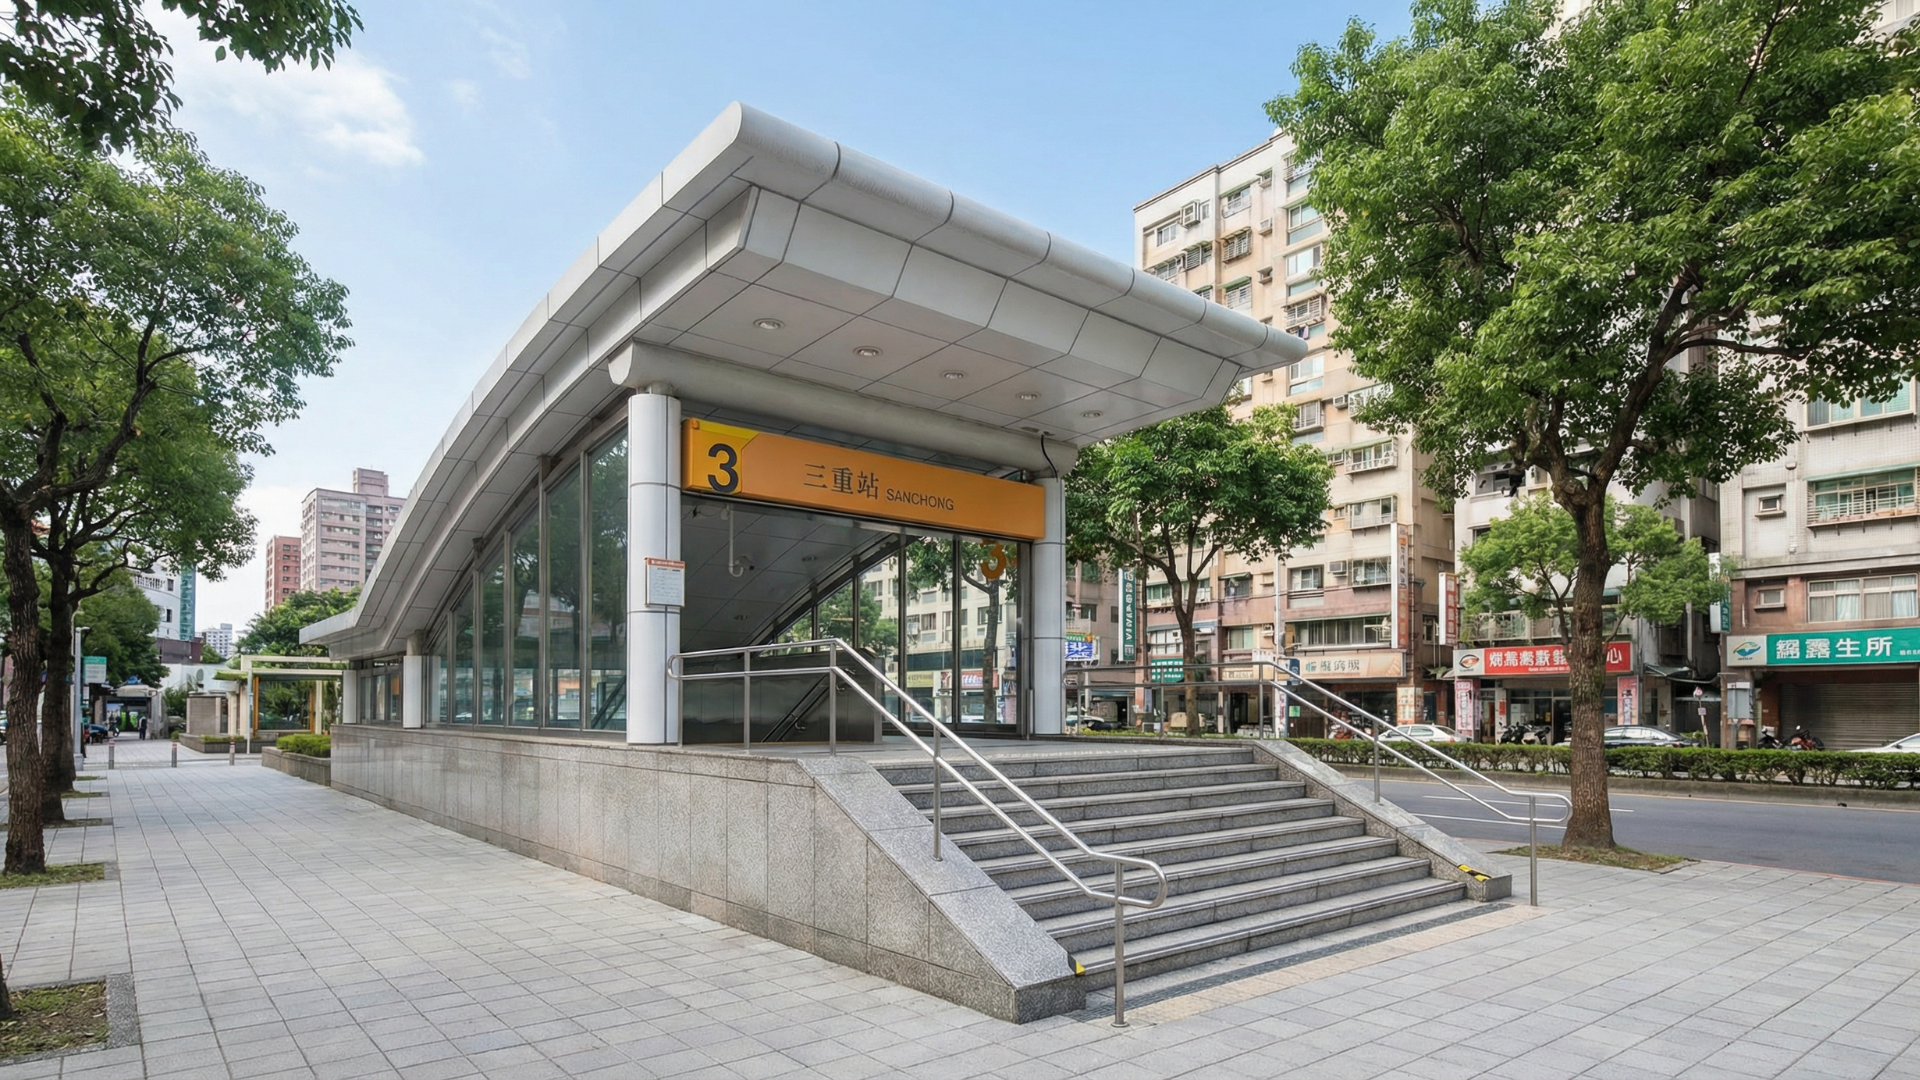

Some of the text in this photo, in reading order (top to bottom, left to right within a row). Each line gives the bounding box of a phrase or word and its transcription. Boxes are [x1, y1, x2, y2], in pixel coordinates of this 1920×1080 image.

[707, 443, 739, 493] 3
[803, 463, 879, 500] 三重站
[886, 488, 954, 511] SANCHONG
